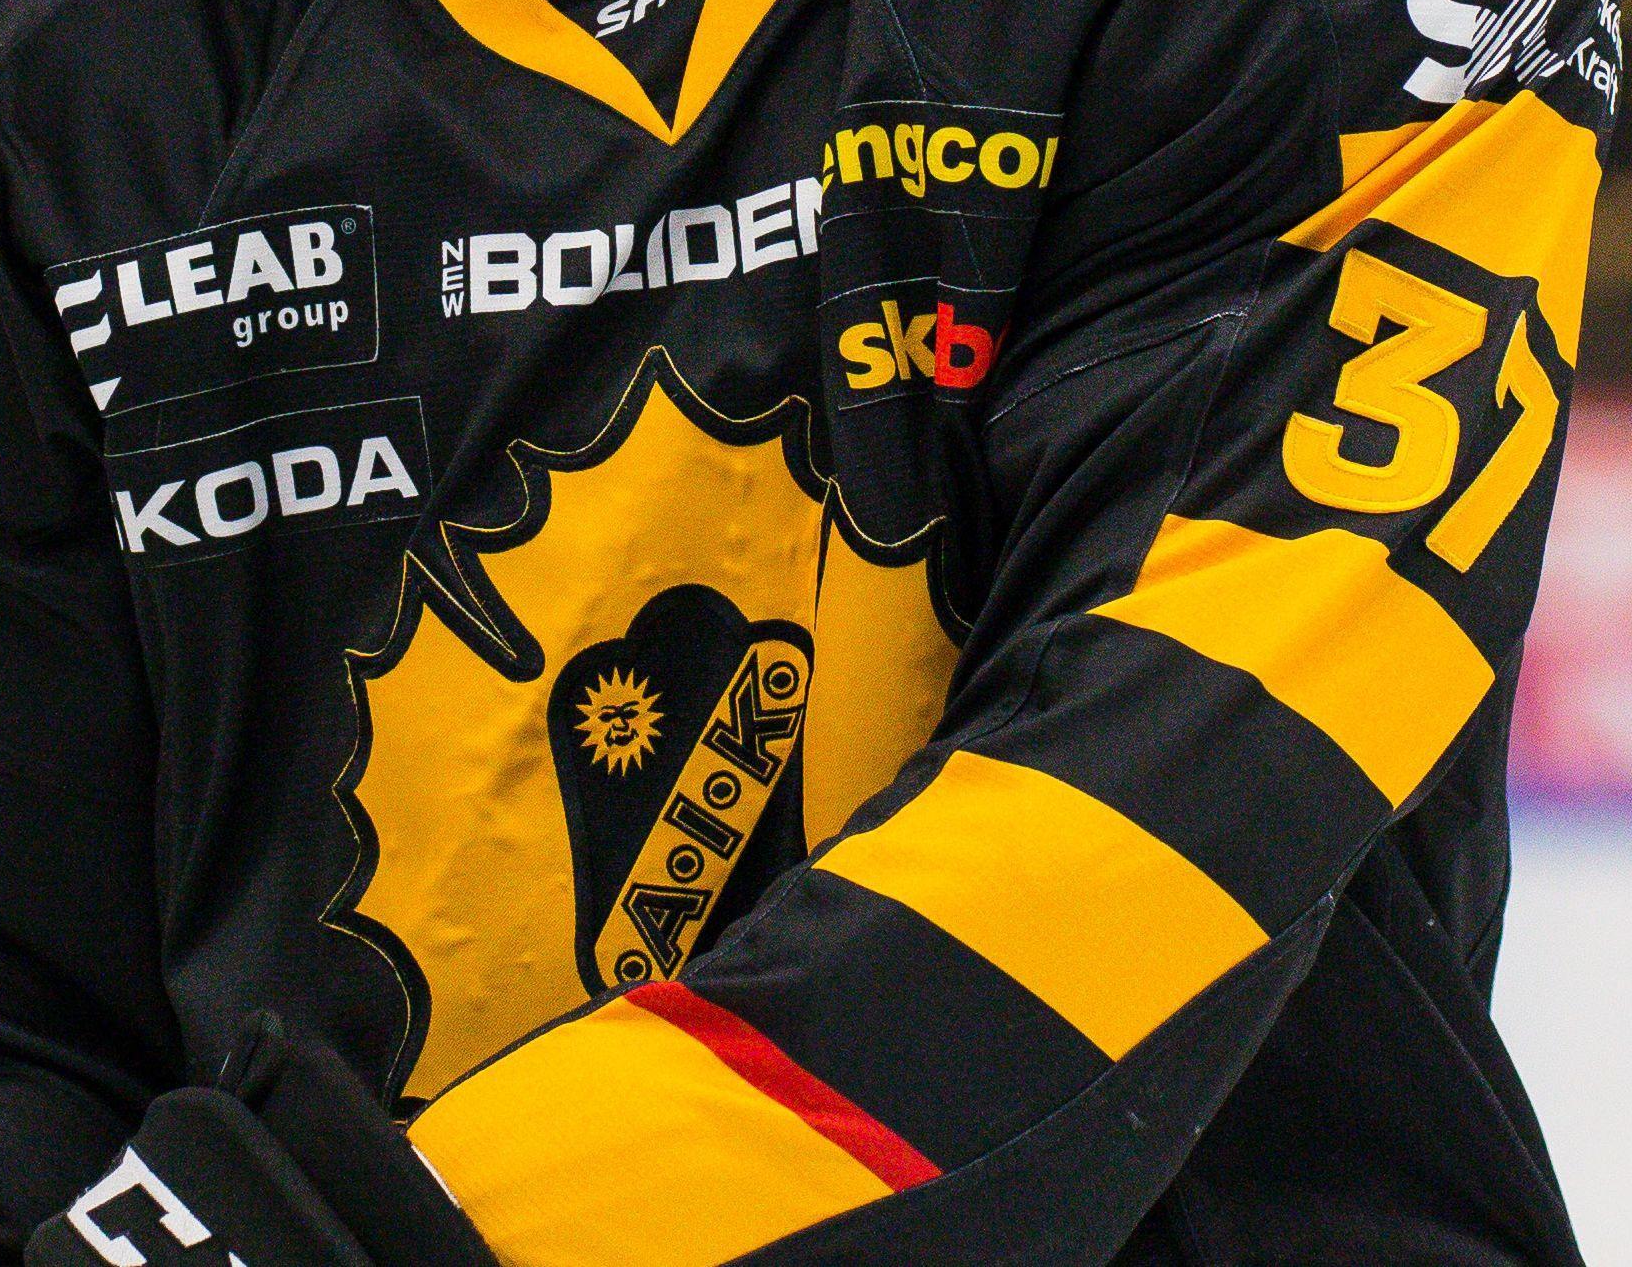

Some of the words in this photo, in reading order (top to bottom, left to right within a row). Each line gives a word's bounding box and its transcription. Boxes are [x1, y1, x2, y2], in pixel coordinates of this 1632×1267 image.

[232, 298, 350, 348] group
[441, 238, 464, 319] NEW
[1282, 247, 1560, 574] 37
[110, 435, 420, 554] KODA
